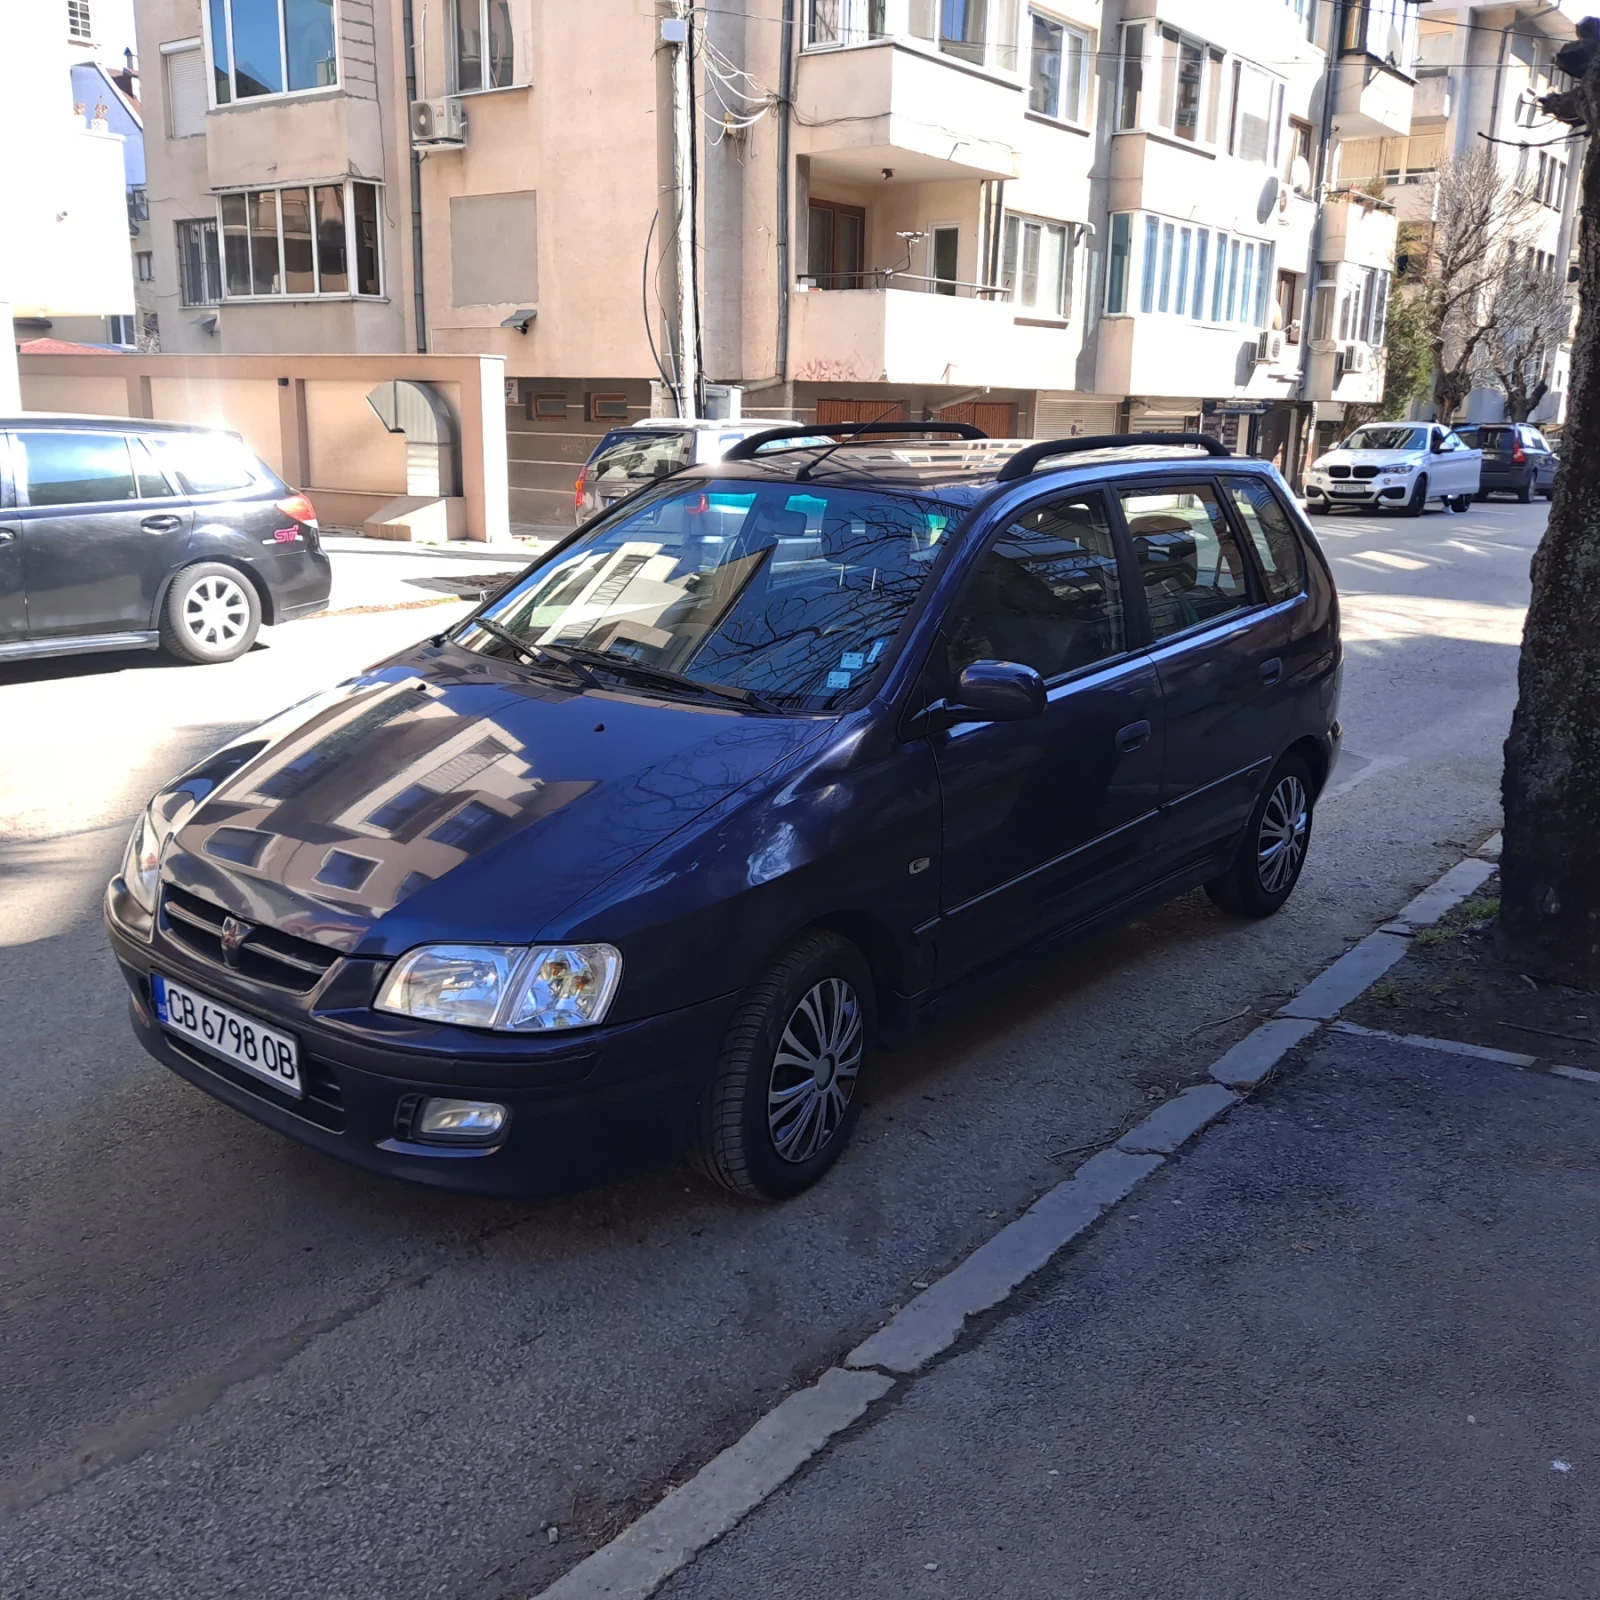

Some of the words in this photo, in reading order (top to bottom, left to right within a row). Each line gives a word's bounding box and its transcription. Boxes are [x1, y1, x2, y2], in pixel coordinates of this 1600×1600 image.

[168, 988, 197, 1031] CB
[202, 1005, 258, 1062] 6798
[262, 1035, 295, 1080] OB
